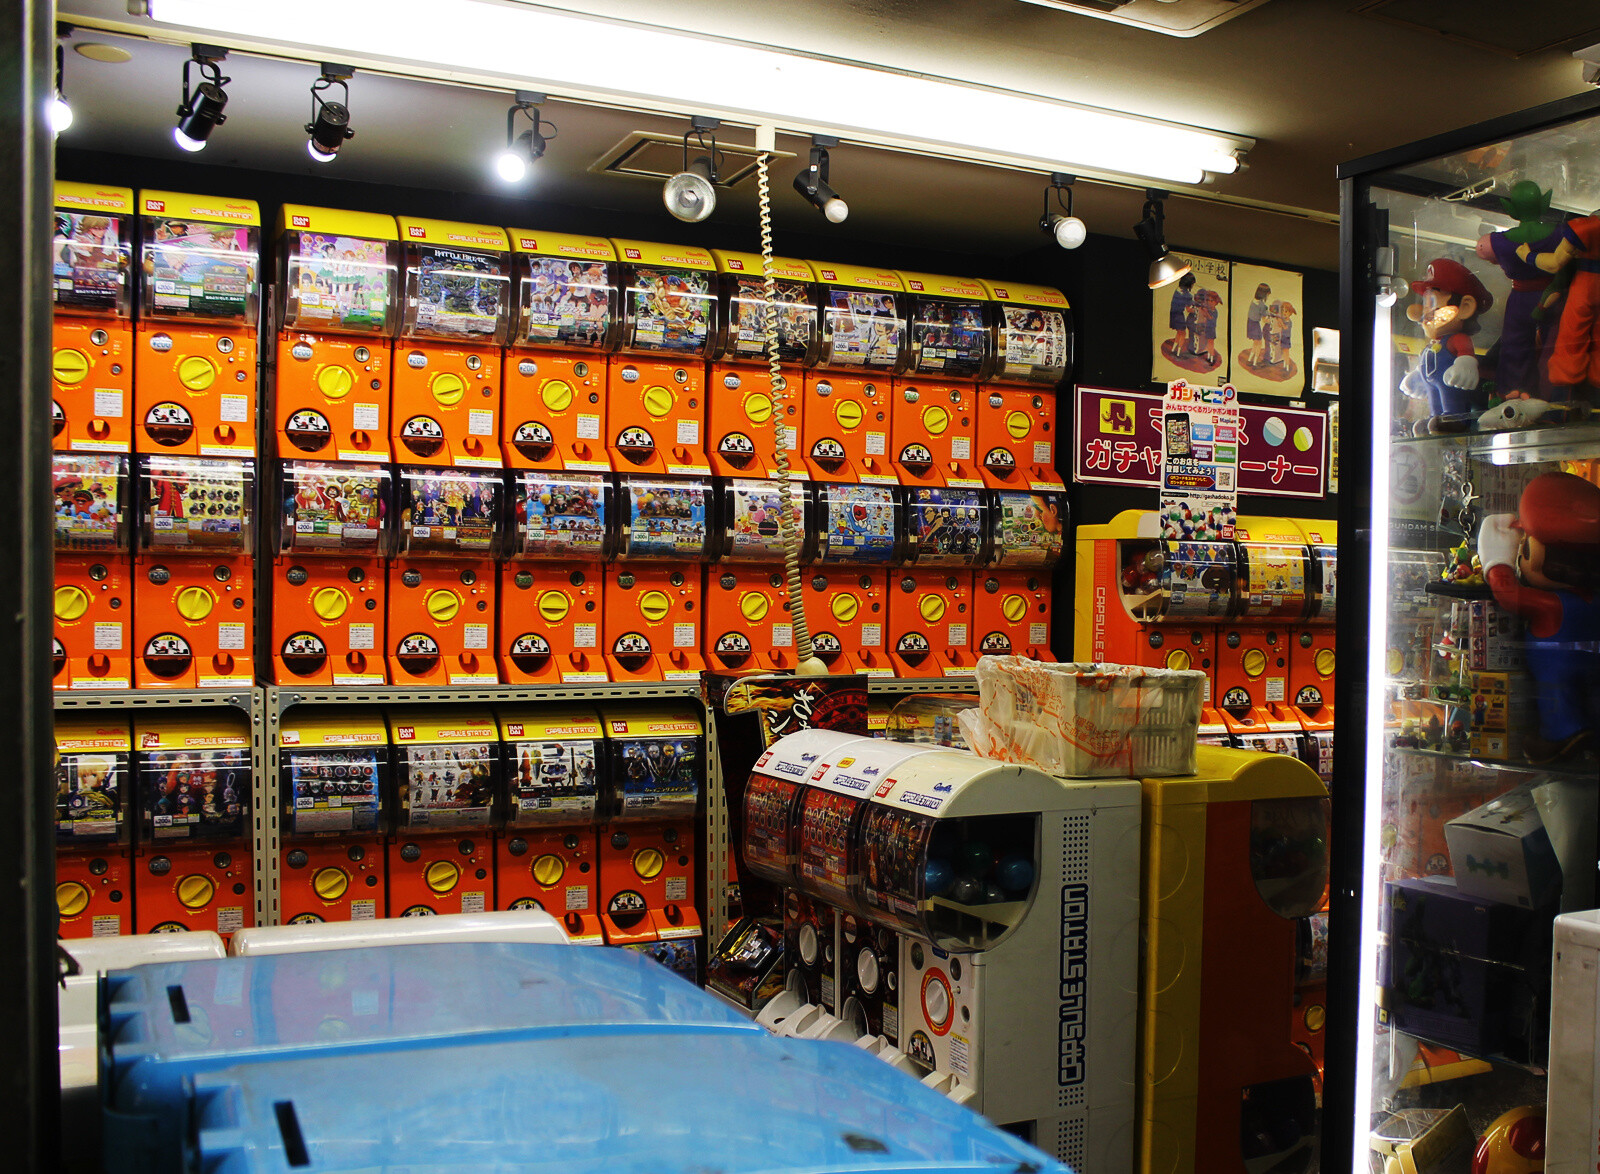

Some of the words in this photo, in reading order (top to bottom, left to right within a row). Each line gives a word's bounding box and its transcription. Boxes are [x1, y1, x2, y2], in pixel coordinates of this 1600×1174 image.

[478, 237, 503, 245] STATION
[435, 250, 460, 260] BATTLE
[462, 254, 488, 264] BREAK
[1086, 438, 1319, 484] ガチャーナー
[1166, 457, 1200, 466] このお店を
[1096, 587, 1105, 649] CAPSULE
[545, 727, 572, 735] CAPSULE
[572, 726, 597, 734] STATION
[217, 737, 245, 745] STATION
[1064, 887, 1087, 980] STATION
[1062, 982, 1084, 1083] CAPSULE
